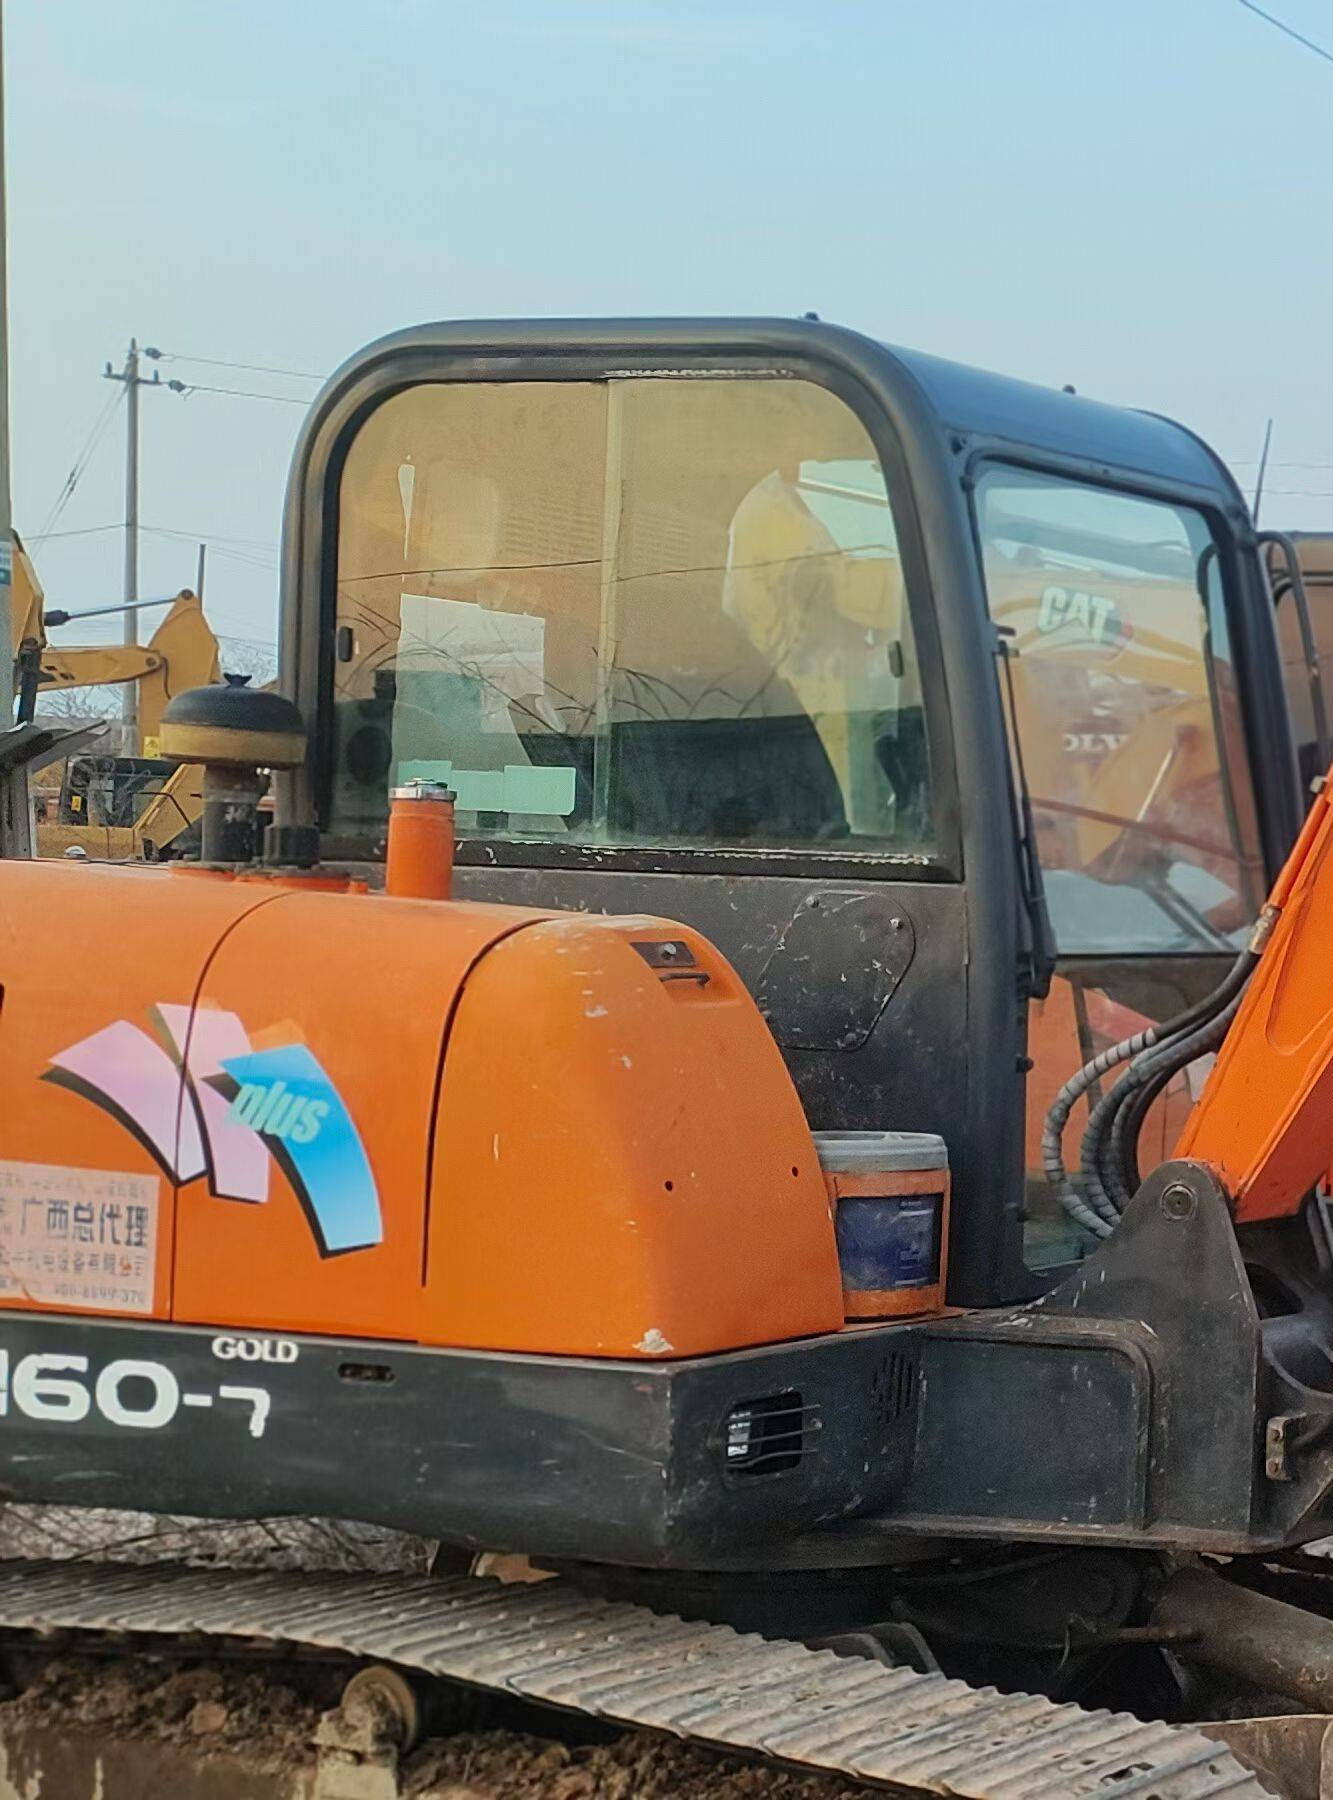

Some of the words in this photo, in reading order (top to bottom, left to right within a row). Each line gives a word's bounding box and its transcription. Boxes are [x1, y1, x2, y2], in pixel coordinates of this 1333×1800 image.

[1037, 586, 1117, 640] CAT
[225, 1081, 330, 1144] plus
[20, 1195, 149, 1247] 广西总代理
[211, 1336, 299, 1363] GOLD
